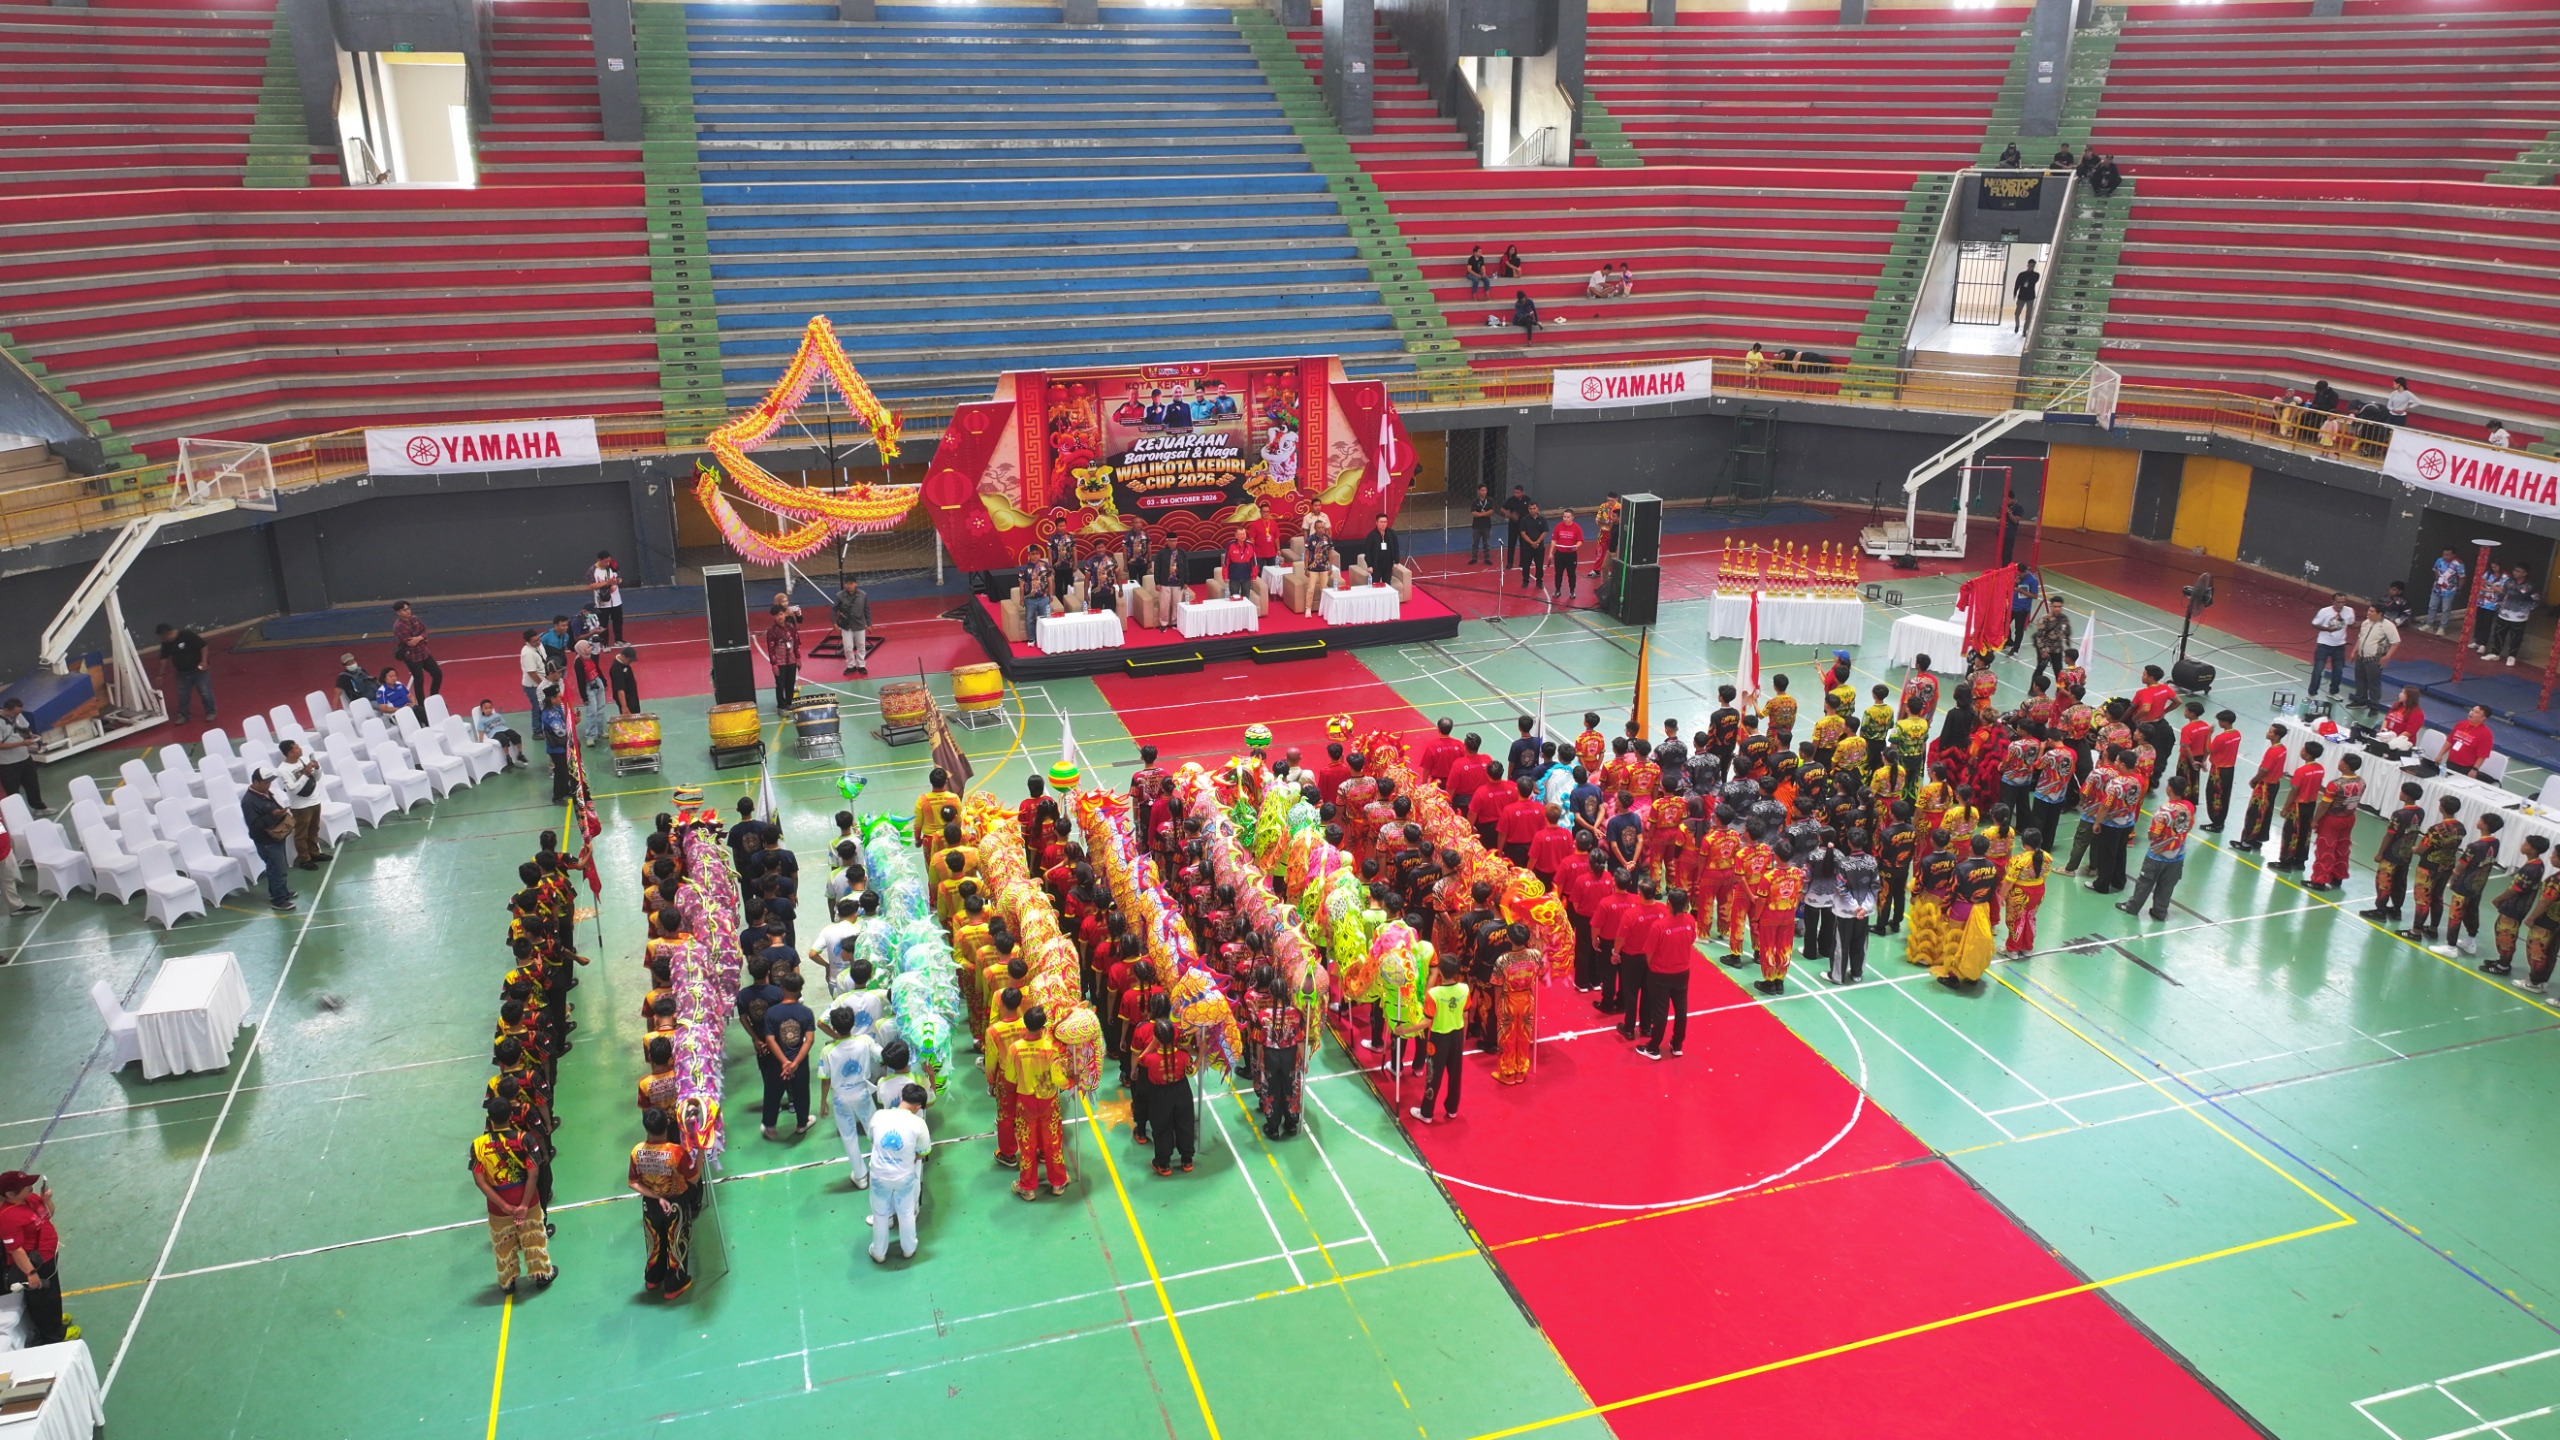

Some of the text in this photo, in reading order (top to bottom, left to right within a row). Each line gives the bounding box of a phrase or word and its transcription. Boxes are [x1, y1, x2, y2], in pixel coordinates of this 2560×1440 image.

[1984, 177, 2039, 188] NONSTOP
[1989, 187, 2030, 198] FLYING
[1125, 381, 1153, 391] KOTA
[1157, 379, 1189, 390] KEDIRI
[1605, 371, 1685, 399] YAMAHA
[440, 431, 561, 463] YAMAHA
[1134, 433, 1229, 452] KEJUARAAN
[1123, 446, 1238, 465] Barongsai & Naga
[1116, 458, 1247, 482] WALIKOTA KEDIRI
[1145, 472, 1216, 491] CUP 2026
[2450, 455, 2558, 506] YAMAHA
[1169, 495, 1201, 505] OKTOBER
[1201, 494, 1217, 502] 2026
[1488, 929, 1507, 942] SMP
